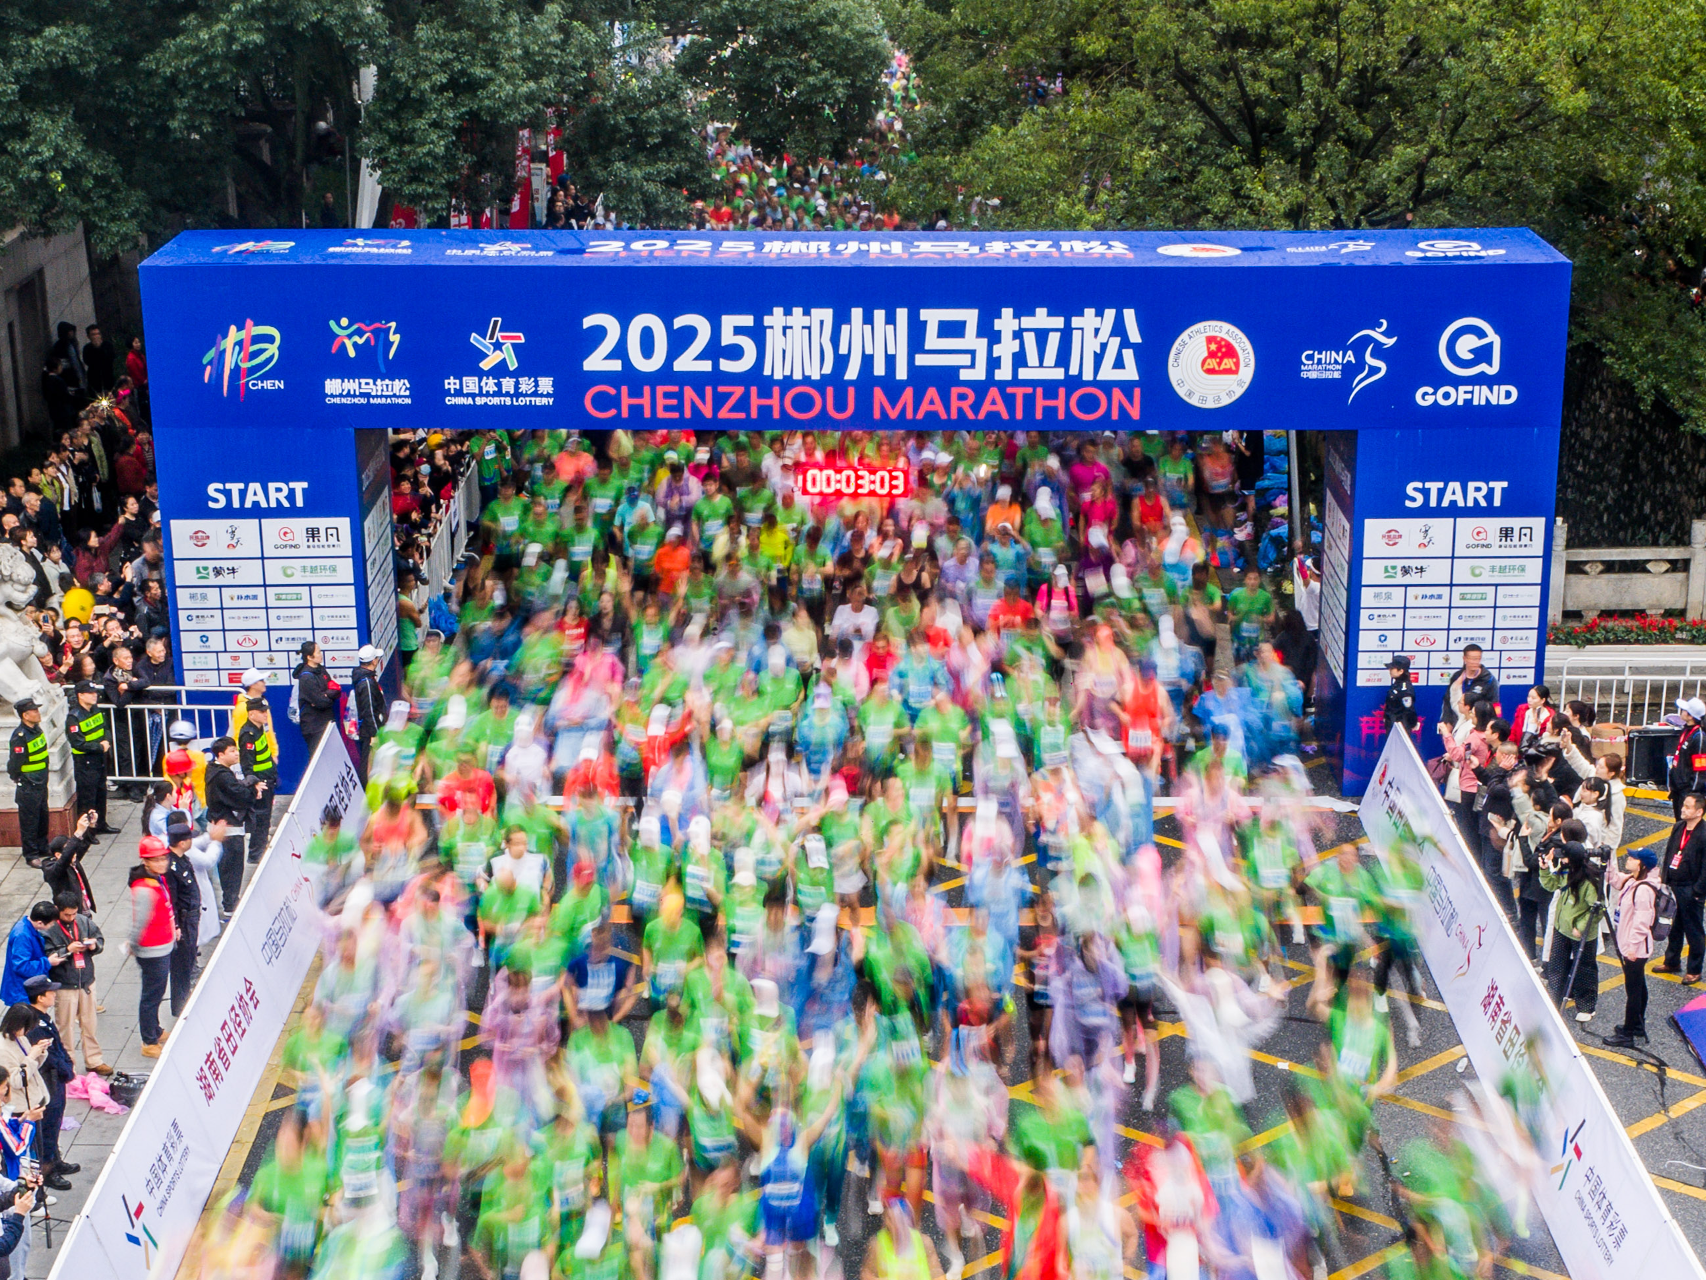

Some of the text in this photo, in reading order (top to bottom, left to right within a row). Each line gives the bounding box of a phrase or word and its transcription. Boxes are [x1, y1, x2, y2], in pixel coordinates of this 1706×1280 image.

[581, 306, 1143, 382] 2025郴州马拉松
[1172, 324, 1251, 368] CHINESE ATHLETICS ASSOCIATION
[1301, 350, 1356, 364] CHINA
[249, 380, 285, 390] CHEN
[325, 378, 410, 396] 郴州马拉松
[444, 375, 555, 395] 中国体育彩票
[1415, 384, 1518, 407] GOFIND
[325, 397, 412, 405] CHENZHOU MARATHON
[445, 396, 555, 406] CHINA SPORTS LOTTERY
[583, 385, 1143, 421] CHENZHOU MARATHON
[207, 481, 308, 509] START
[805, 468, 905, 495] 00:03:03
[1404, 481, 1508, 508] START
[195, 976, 260, 1107] 湖南省田径协会
[145, 1117, 184, 1200] 中国体育彩票
[156, 1194, 169, 1217] CHINA
[165, 1169, 180, 1199] SPORTS
[1574, 1189, 1587, 1213] CHINA
[1584, 1208, 1599, 1239] SPORTS
[1583, 1165, 1628, 1252] 中国体育彩票
